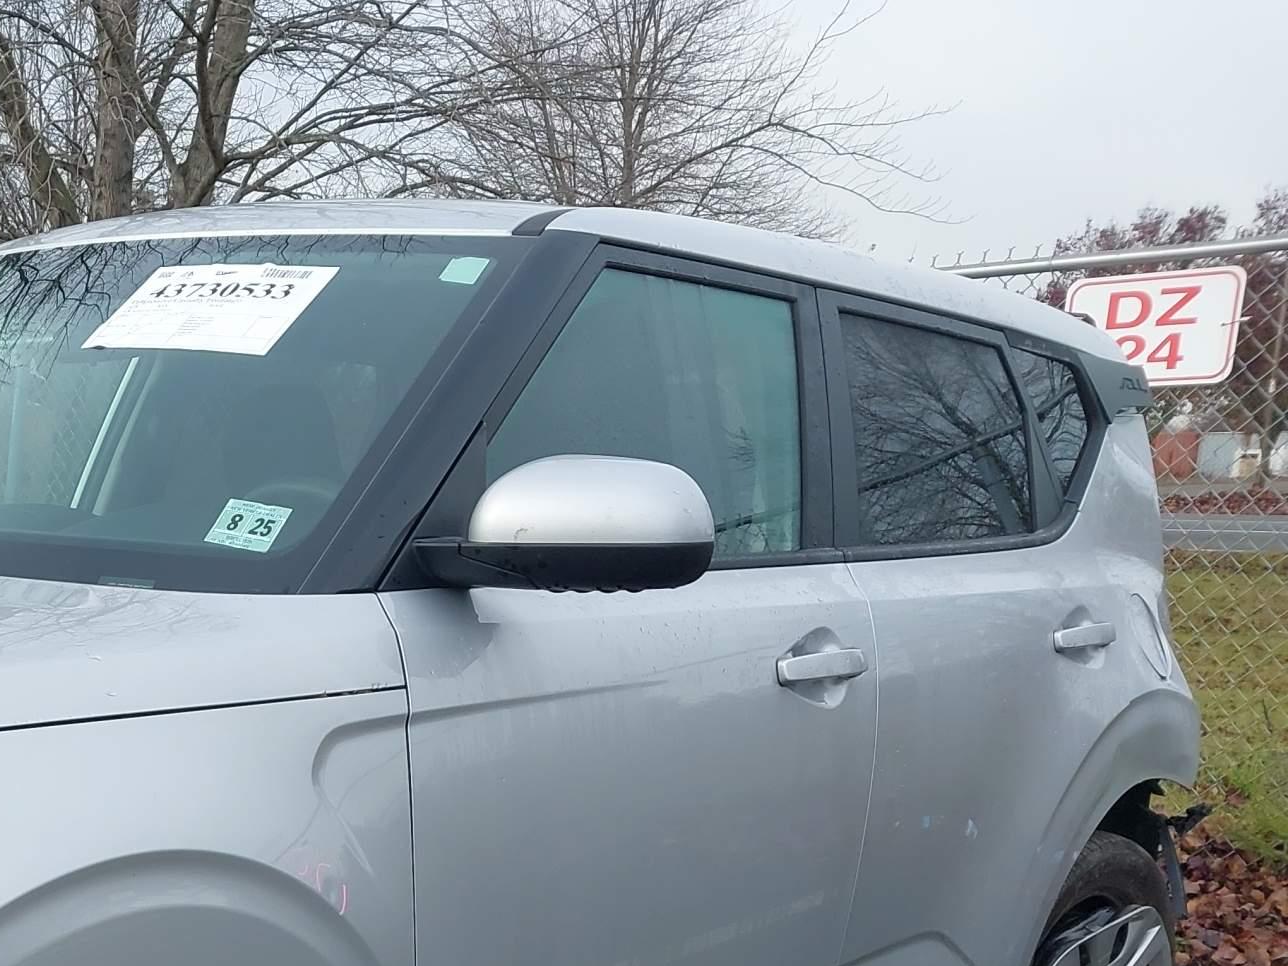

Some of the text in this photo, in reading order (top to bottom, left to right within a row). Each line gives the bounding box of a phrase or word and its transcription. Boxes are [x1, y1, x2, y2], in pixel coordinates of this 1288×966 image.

[150, 283, 295, 299] 43730533
[1106, 286, 1203, 330] DZ
[1116, 333, 1184, 369] 24
[226, 513, 275, 537] 8 25
